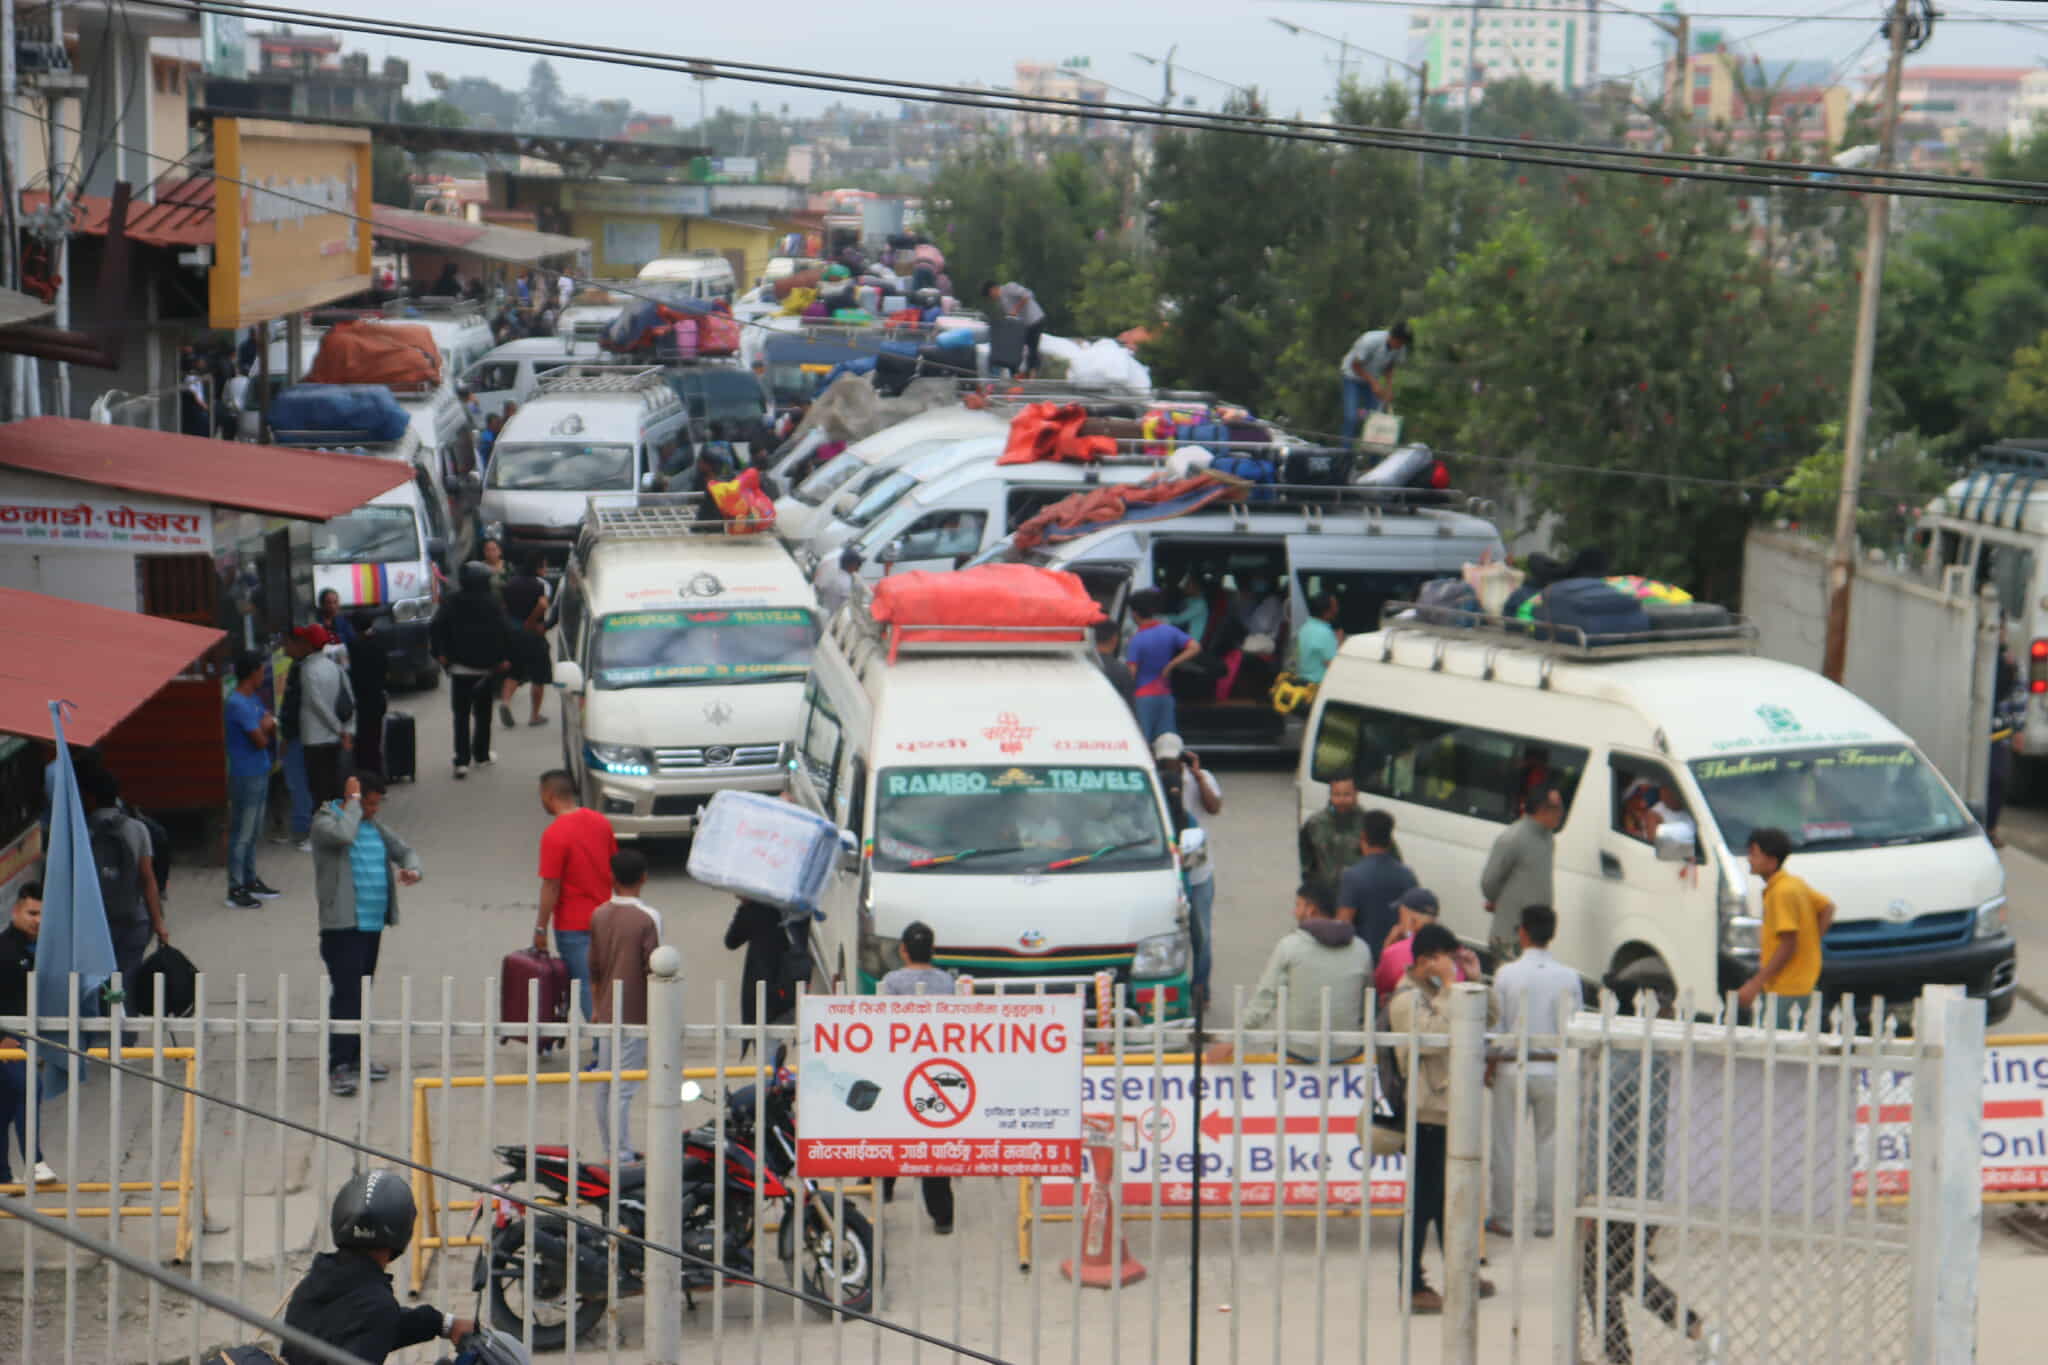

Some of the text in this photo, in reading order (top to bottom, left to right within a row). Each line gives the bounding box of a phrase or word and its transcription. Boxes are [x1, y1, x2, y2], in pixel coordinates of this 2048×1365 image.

[889, 769, 1145, 794] RAMBO TRAVELS
[814, 1022, 1068, 1054] NO PARKING
[1081, 1067, 1372, 1100] asement Park
[1980, 1128, 2048, 1159] Onl
[1249, 1146, 1332, 1172] Bke
[1347, 1146, 1403, 1173] On
